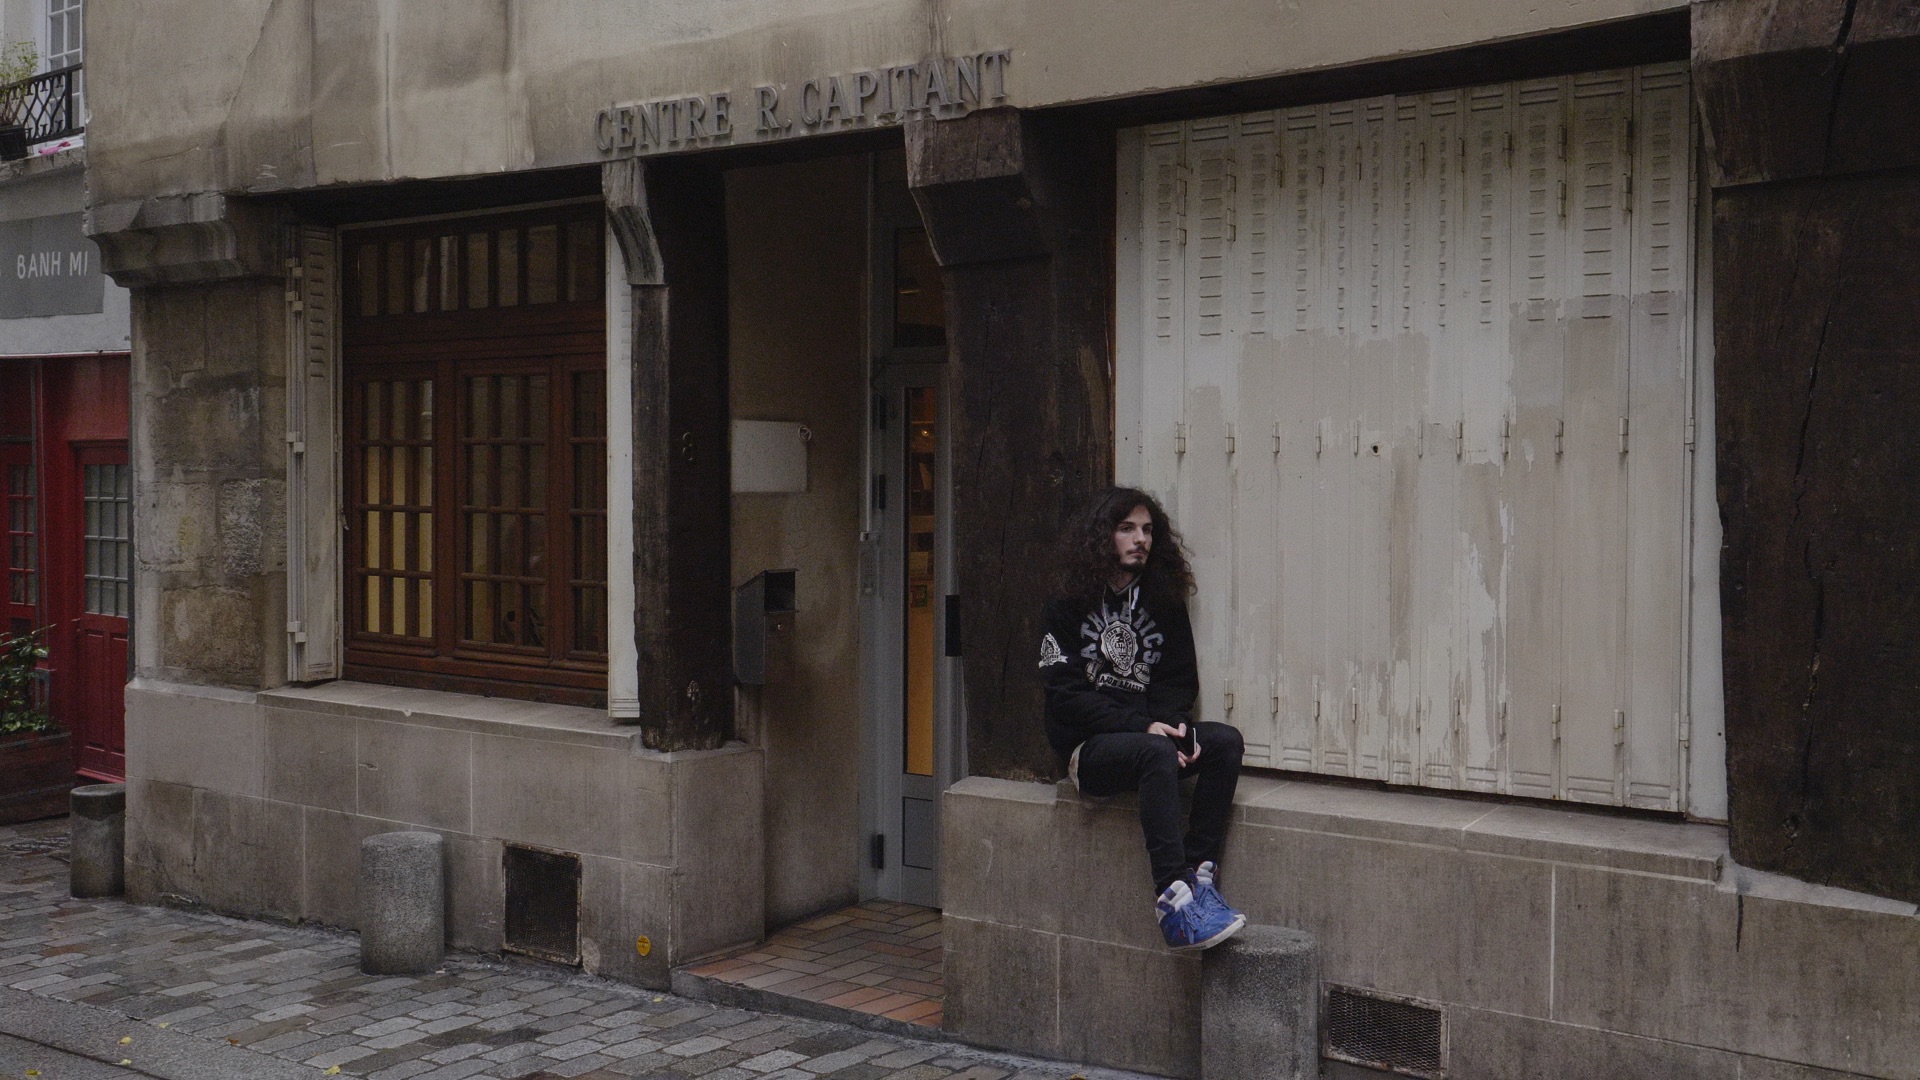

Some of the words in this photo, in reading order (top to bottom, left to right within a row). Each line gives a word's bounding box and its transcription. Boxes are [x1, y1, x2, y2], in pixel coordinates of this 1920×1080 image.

[593, 92, 734, 152] CENTRE
[802, 49, 1012, 126] CAPITANT
[17, 251, 61, 279] BANH
[69, 251, 88, 276] MI
[1080, 601, 1164, 665] ATHLETICS
